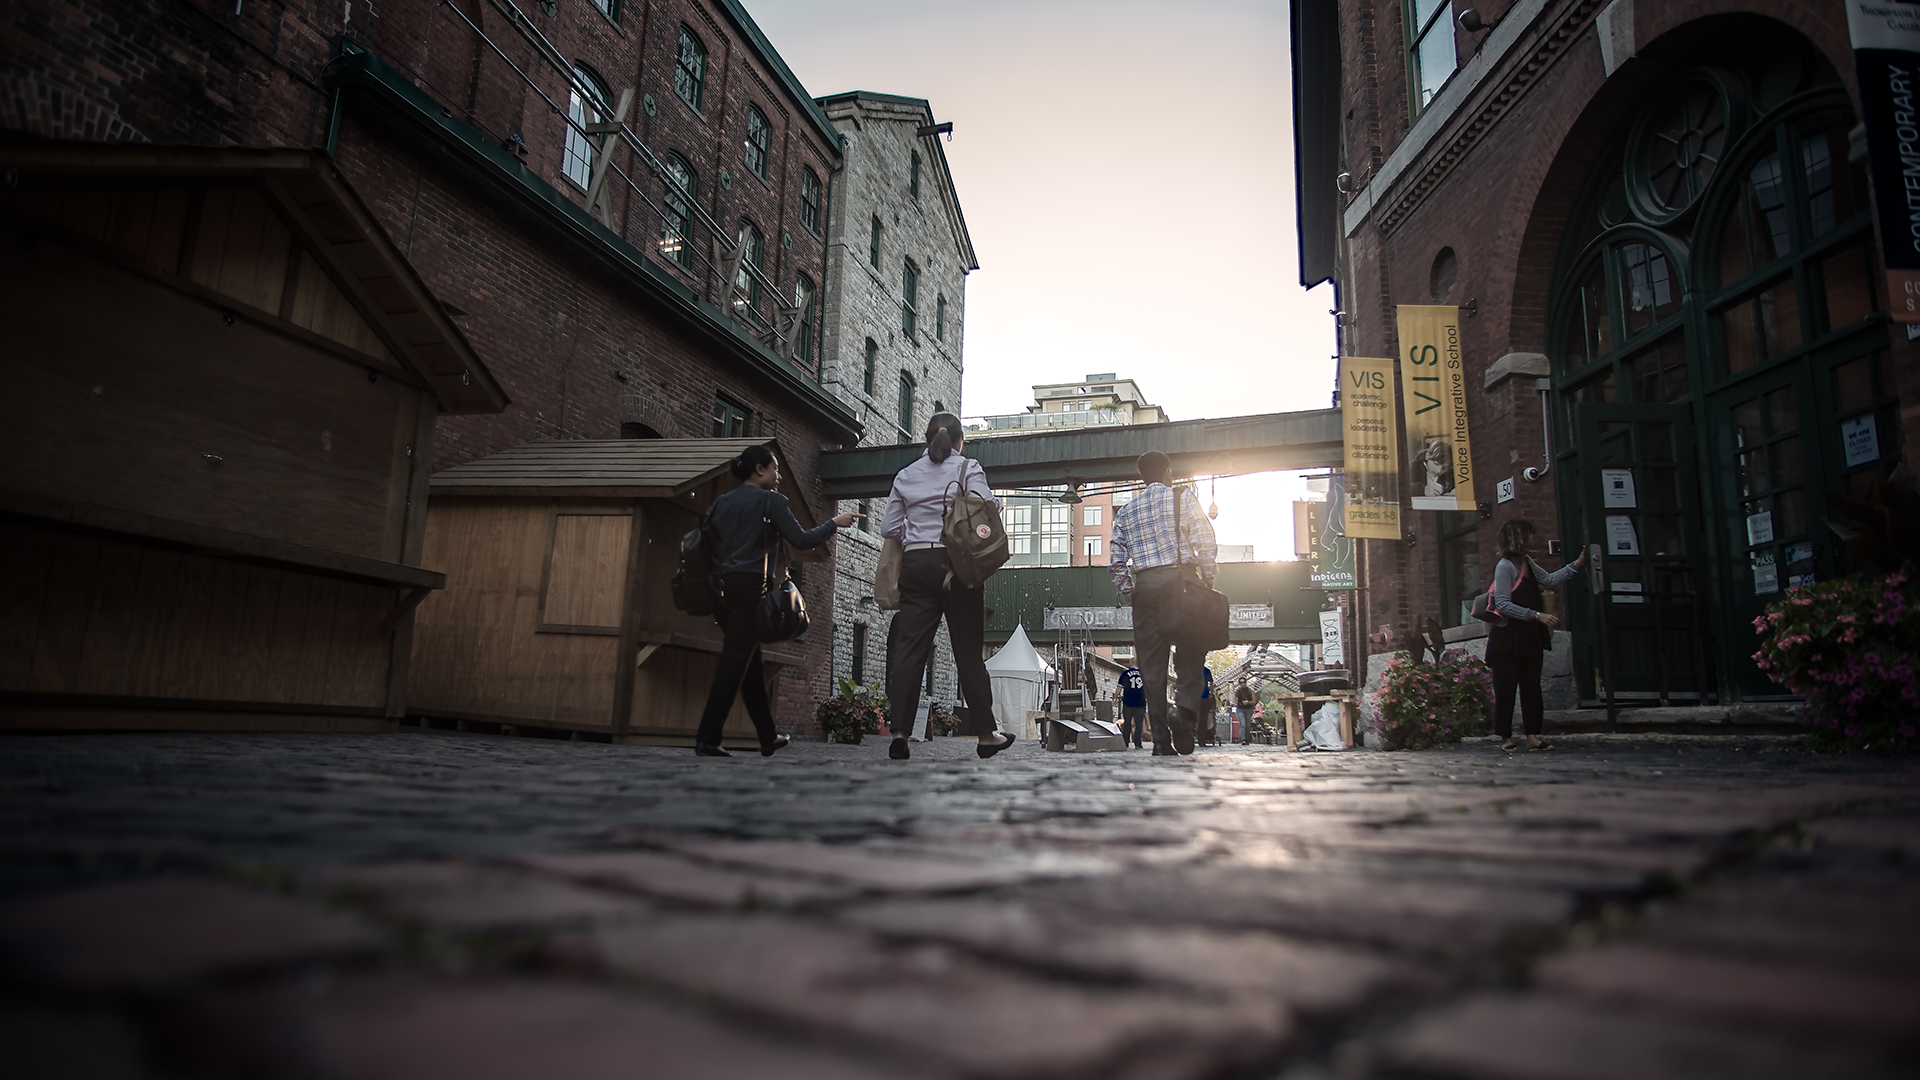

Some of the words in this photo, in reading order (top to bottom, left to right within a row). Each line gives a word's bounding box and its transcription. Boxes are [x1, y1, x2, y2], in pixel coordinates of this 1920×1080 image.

[1888, 63, 1920, 253] NTEMPORARY
[1444, 325, 1460, 370] School
[1349, 370, 1385, 390] VIS
[1410, 345, 1442, 415] VIS
[1353, 400, 1387, 410] challenge
[1450, 373, 1467, 443] Integrative
[1356, 418, 1384, 426] personal
[1350, 423, 1387, 434] leadership
[1858, 428, 1870, 436] ARE
[1848, 436, 1871, 447] CLOSED
[1351, 444, 1387, 452] responsible
[1352, 451, 1389, 461] citizenship
[1456, 447, 1470, 485] Voice
[1502, 482, 1512, 497] 50
[1349, 510, 1380, 520] grades
[1382, 510, 1396, 520] 1-8
[1755, 555, 1774, 566] PASS
[1050, 611, 1132, 625] GOODERH
[1234, 611, 1266, 620] LIMITED
[1130, 677, 1143, 689] 19
